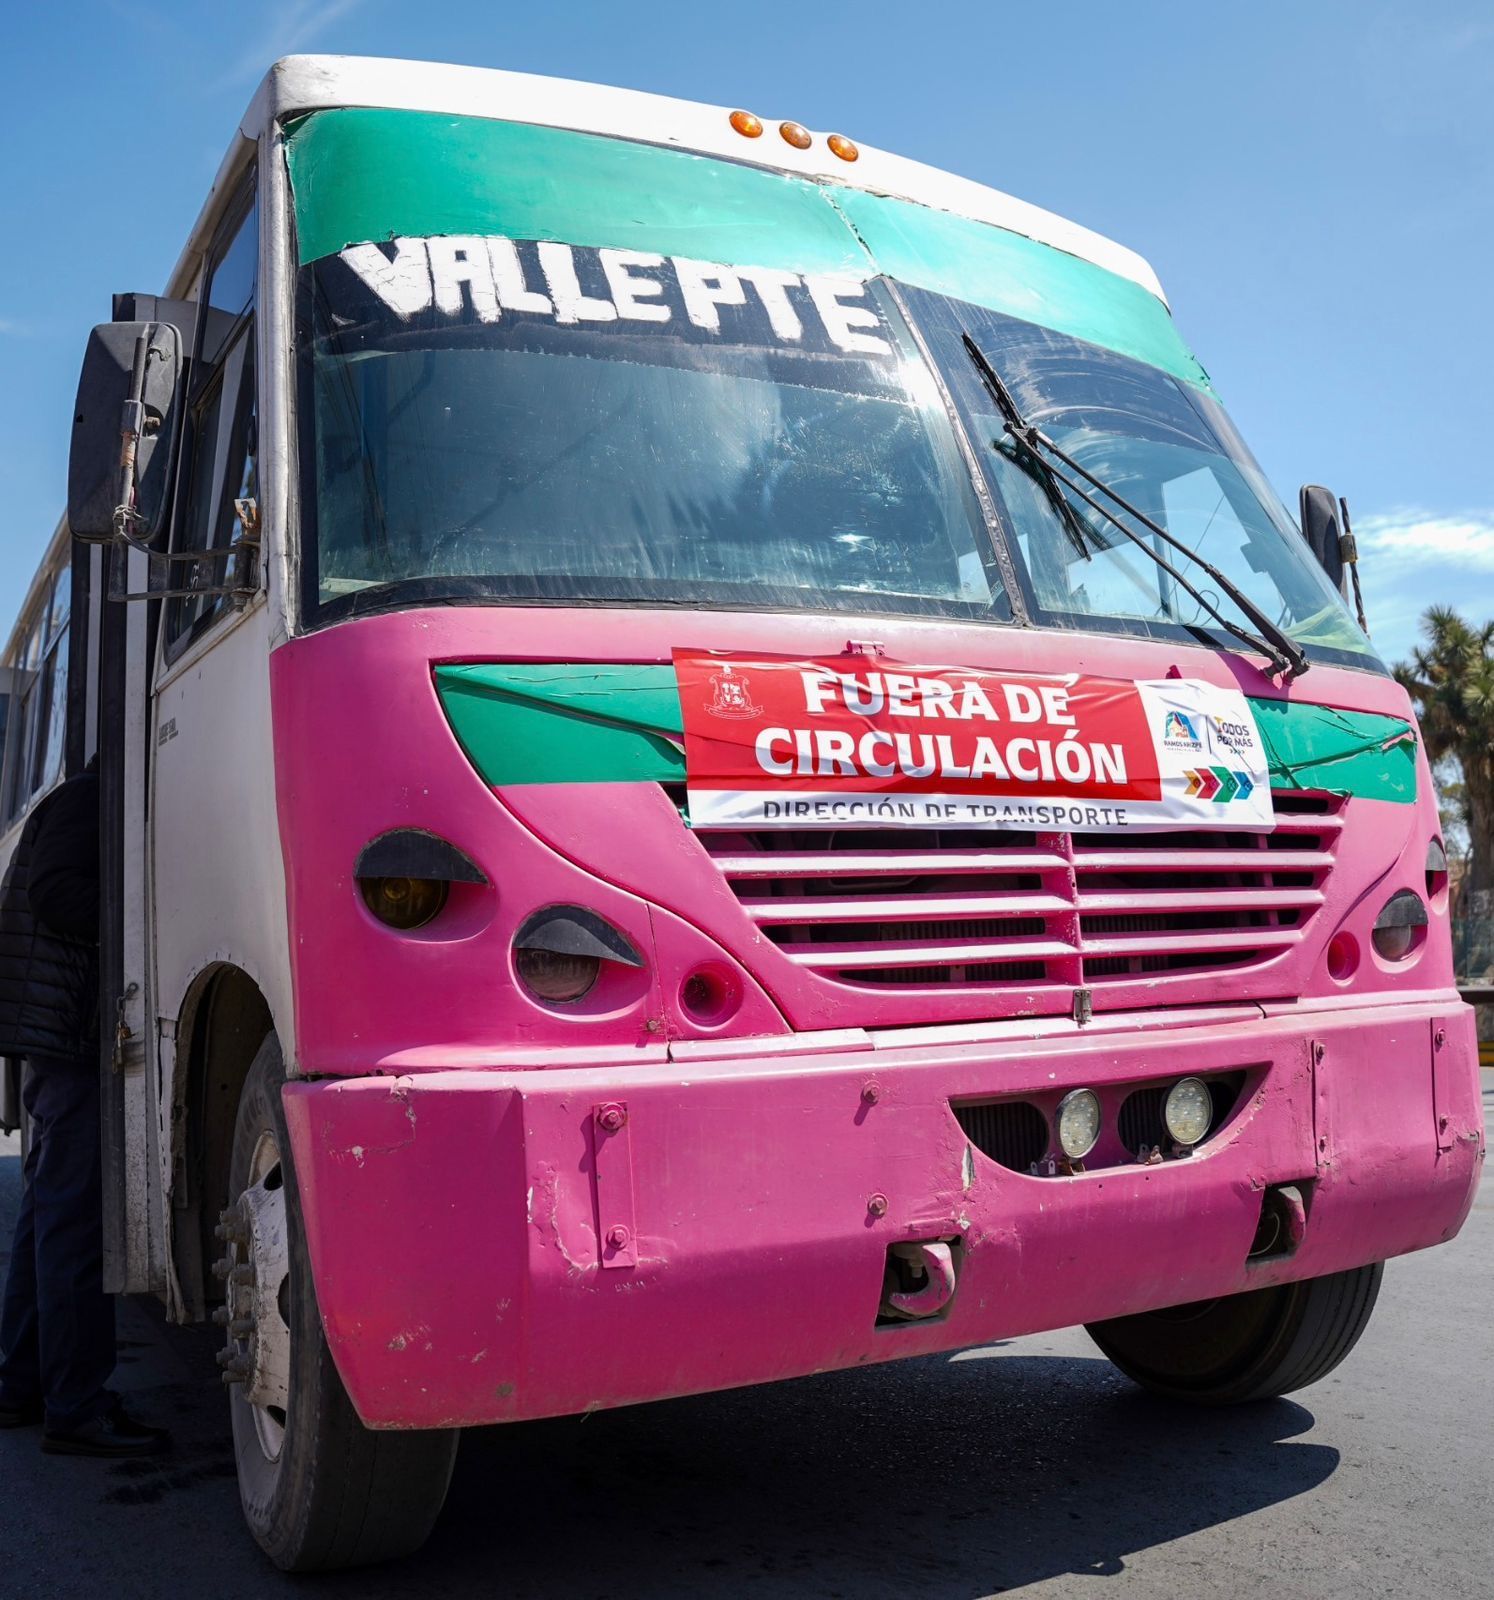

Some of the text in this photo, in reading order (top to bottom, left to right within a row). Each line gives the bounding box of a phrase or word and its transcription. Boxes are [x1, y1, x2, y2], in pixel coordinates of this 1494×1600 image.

[801, 671, 1076, 726] FUERA DE
[1213, 716, 1250, 736] TODOS
[755, 727, 1128, 785] CIRCULACIÓN
[763, 797, 915, 820] DIRECCIÓN
[967, 804, 1128, 826] TRANSPORTE
